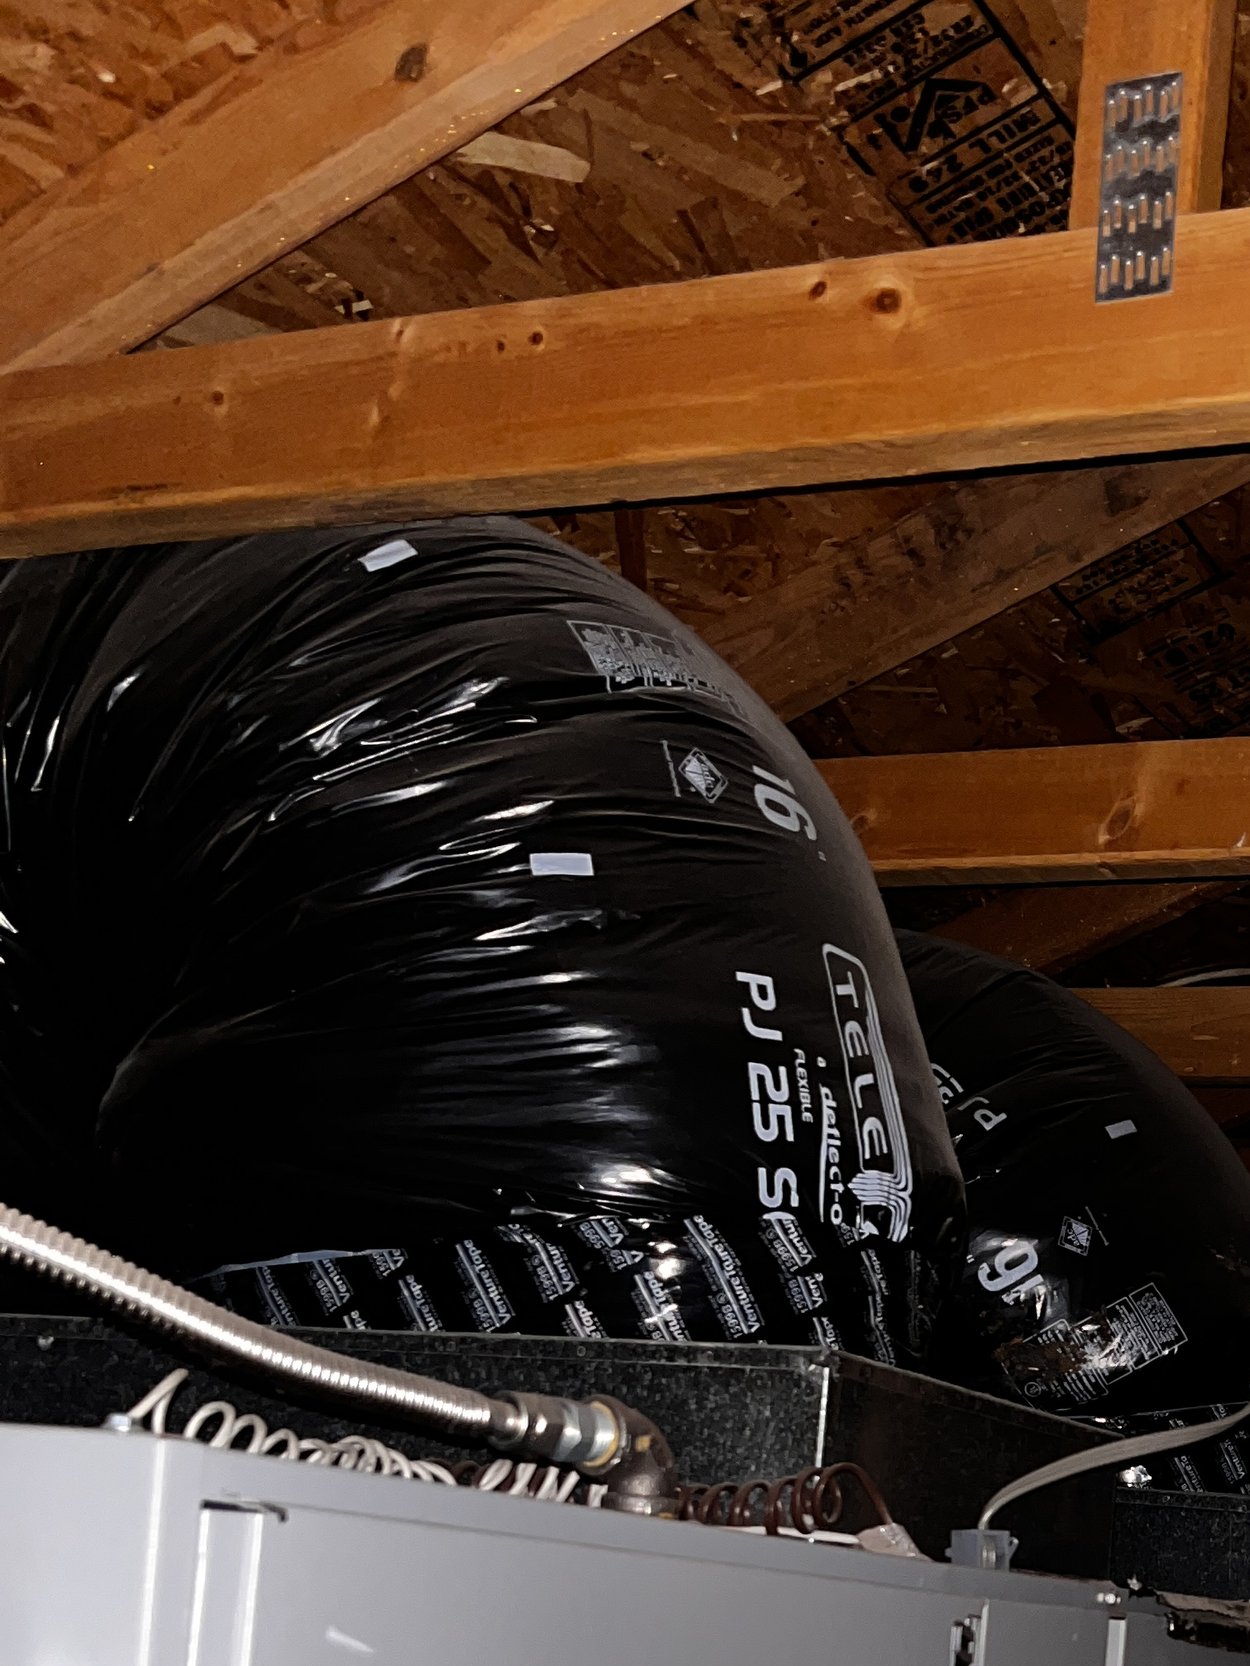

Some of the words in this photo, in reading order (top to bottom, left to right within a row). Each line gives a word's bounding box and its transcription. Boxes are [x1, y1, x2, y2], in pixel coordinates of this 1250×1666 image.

[966, 105, 1042, 161] MILL
[735, 971, 784, 1042] PJ
[747, 1060, 795, 1143] 25
[794, 1047, 814, 1123] FLEXIBLE
[459, 1236, 515, 1324] VentureTape
